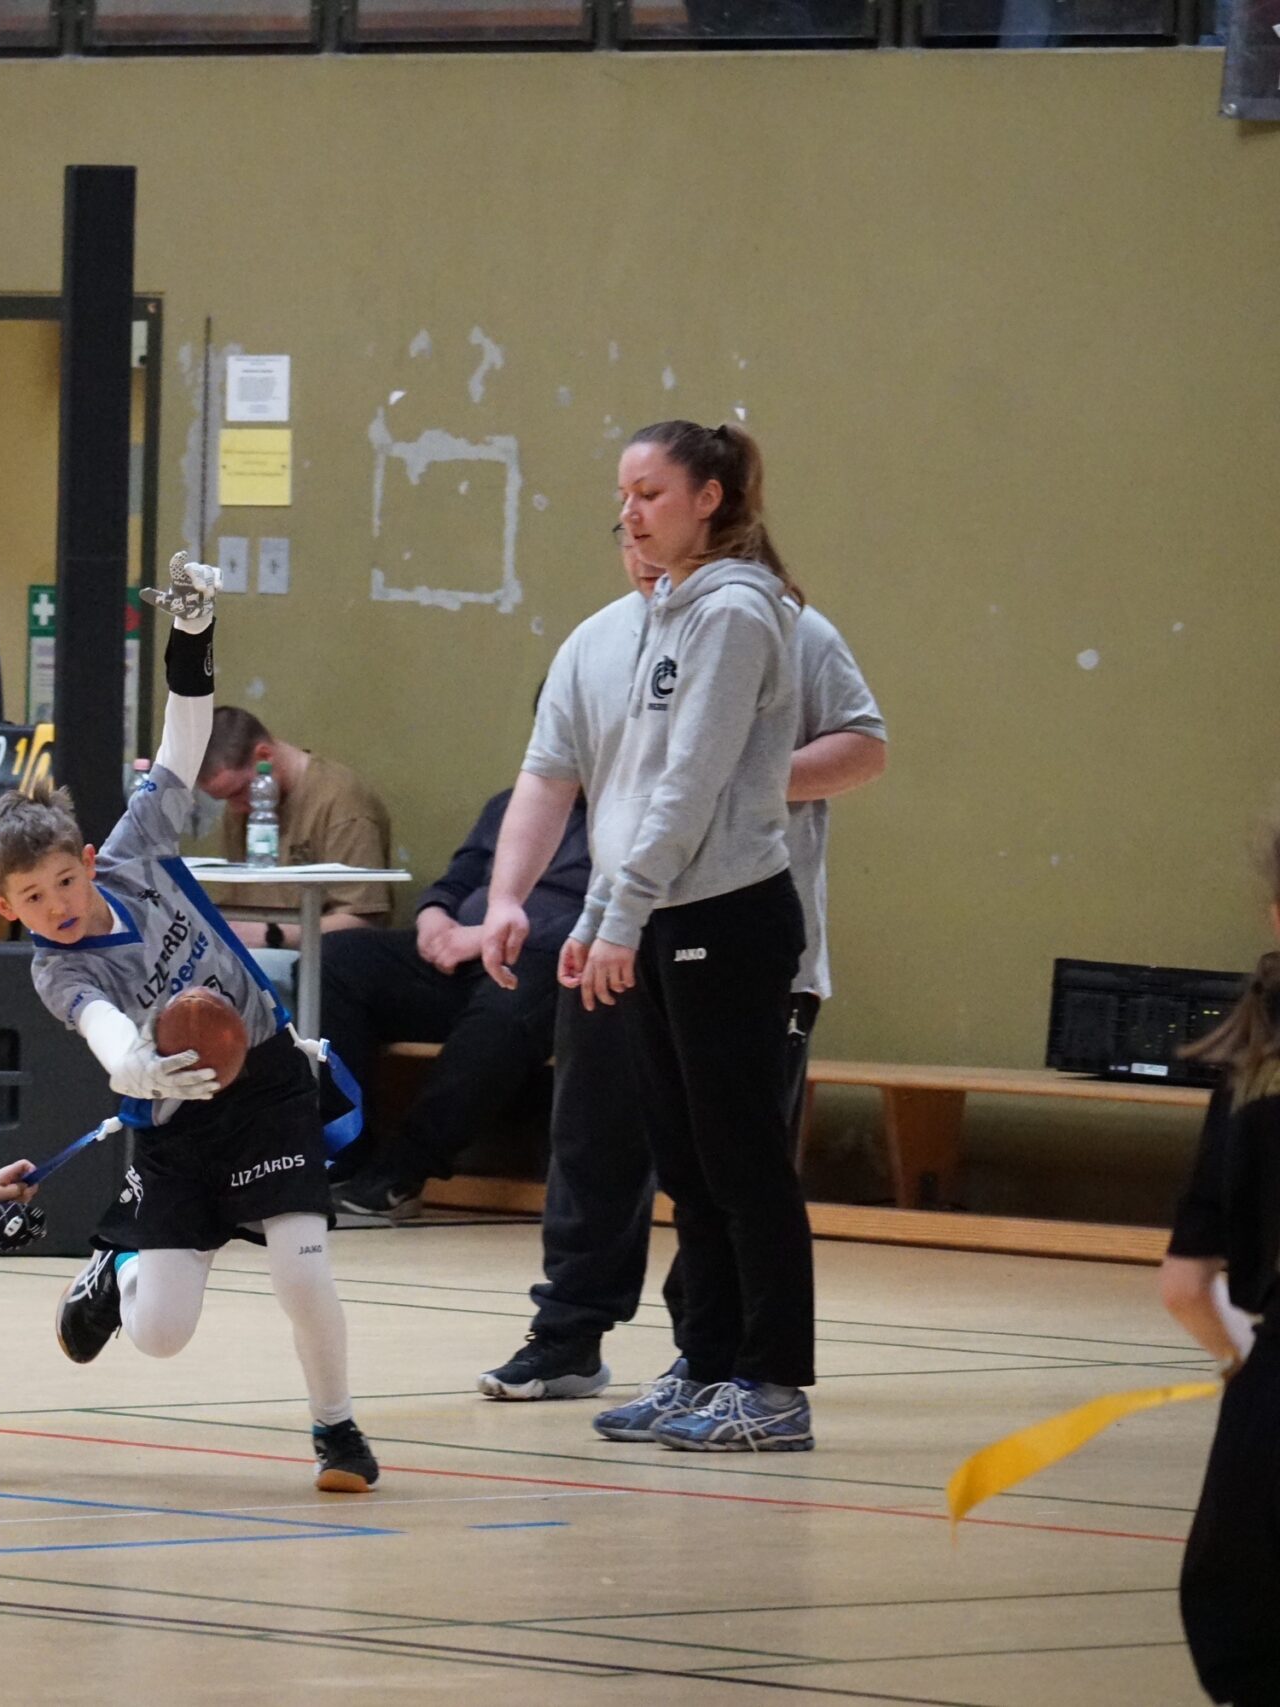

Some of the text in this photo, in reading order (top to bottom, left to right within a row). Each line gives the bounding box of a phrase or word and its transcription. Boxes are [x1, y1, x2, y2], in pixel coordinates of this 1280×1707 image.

[673, 947, 707, 962] JAKO
[230, 1154, 306, 1187] LIZZARDS
[298, 1244, 323, 1255] JAKO
